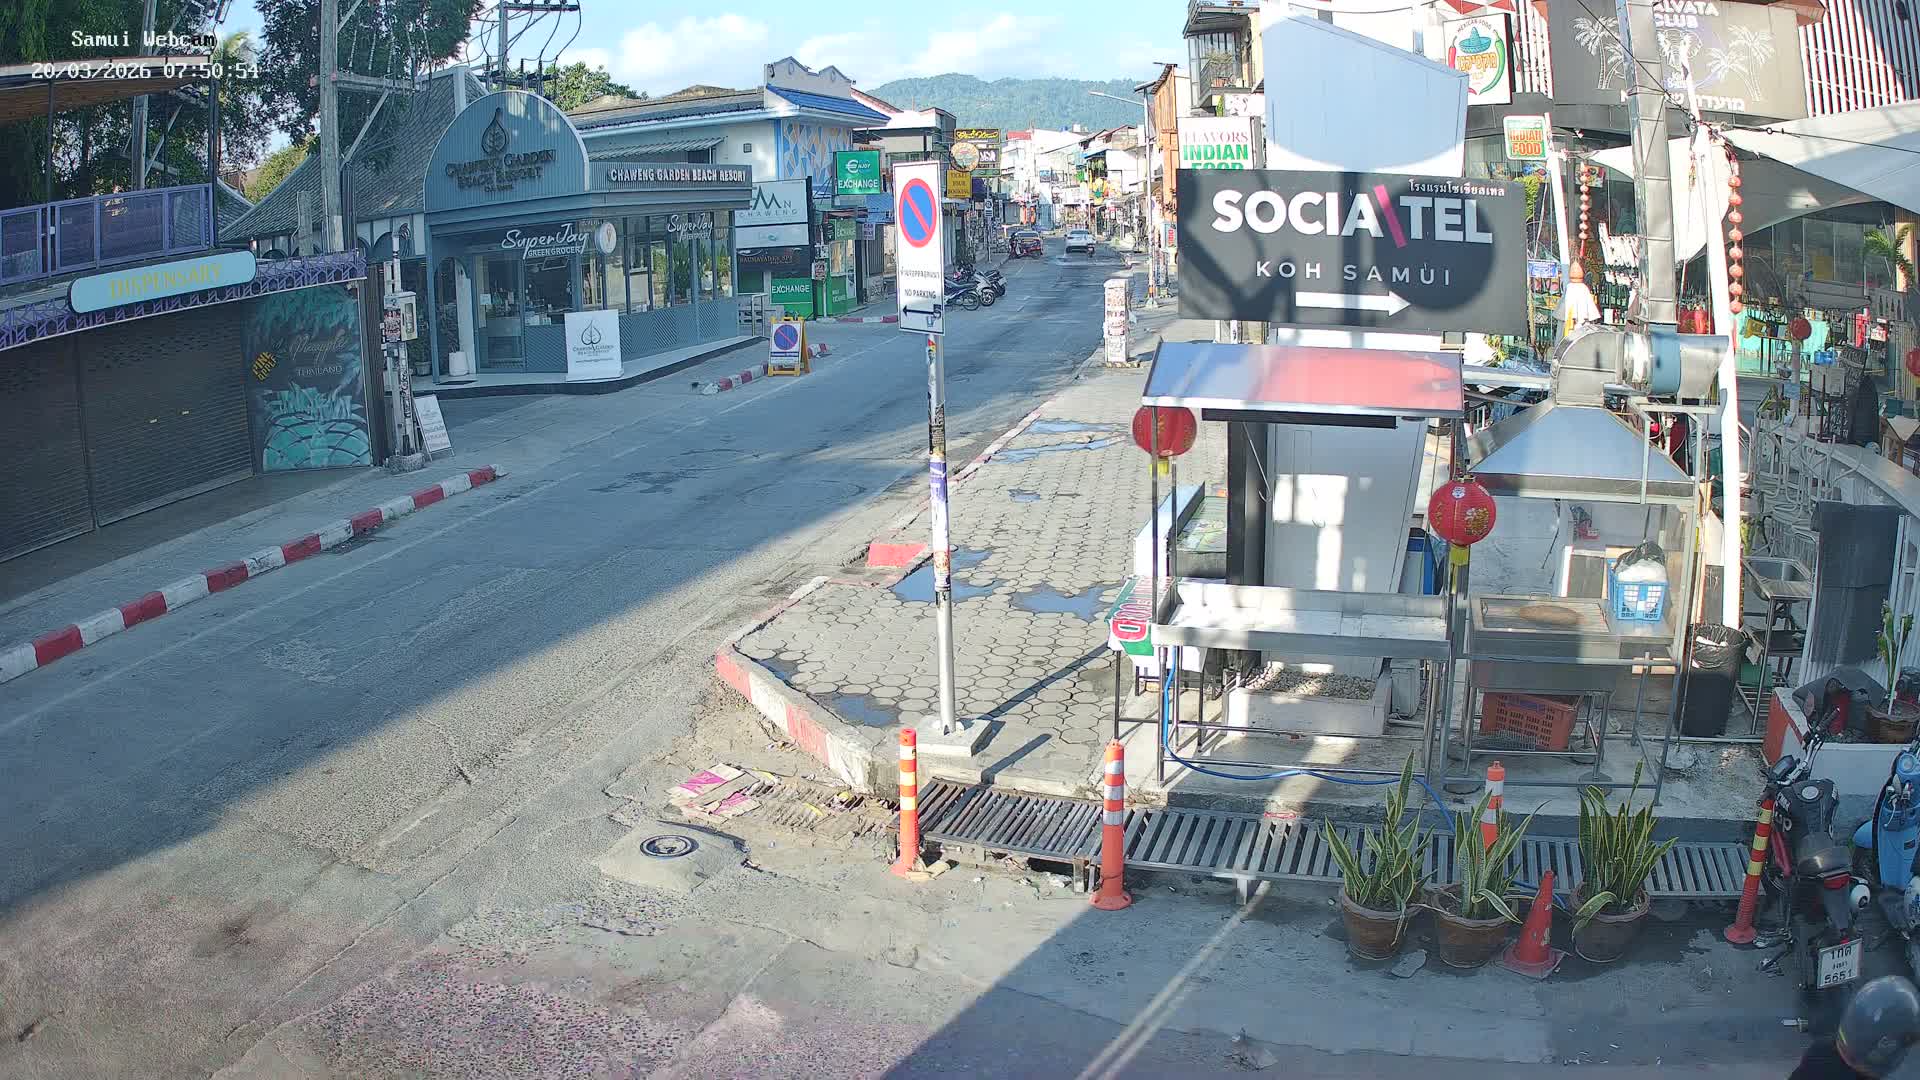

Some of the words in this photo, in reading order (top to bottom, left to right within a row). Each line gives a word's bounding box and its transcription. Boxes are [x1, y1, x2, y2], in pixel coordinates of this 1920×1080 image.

[1655, 13, 1699, 29] CLUB
[1509, 129, 1542, 141] INDIAN
[1183, 144, 1249, 160] INDIAN
[1511, 142, 1542, 155] FOOD
[610, 168, 655, 182] CHAWENG
[656, 168, 690, 182] GARDEN
[692, 169, 718, 182] BEACH
[719, 170, 746, 182] RESORT
[838, 178, 879, 189] EXCHANGE
[528, 248, 550, 257] GREEN
[552, 245, 580, 255] GROCER
[1256, 260, 1322, 279] KOH
[1343, 263, 1450, 287] SAMUI
[110, 264, 222, 299] DISPENSARY
[772, 284, 810, 293] EXCHANGE
[904, 288, 912, 297] NO
[912, 289, 937, 299] PARKING
[1824, 969, 1852, 984] 5651
